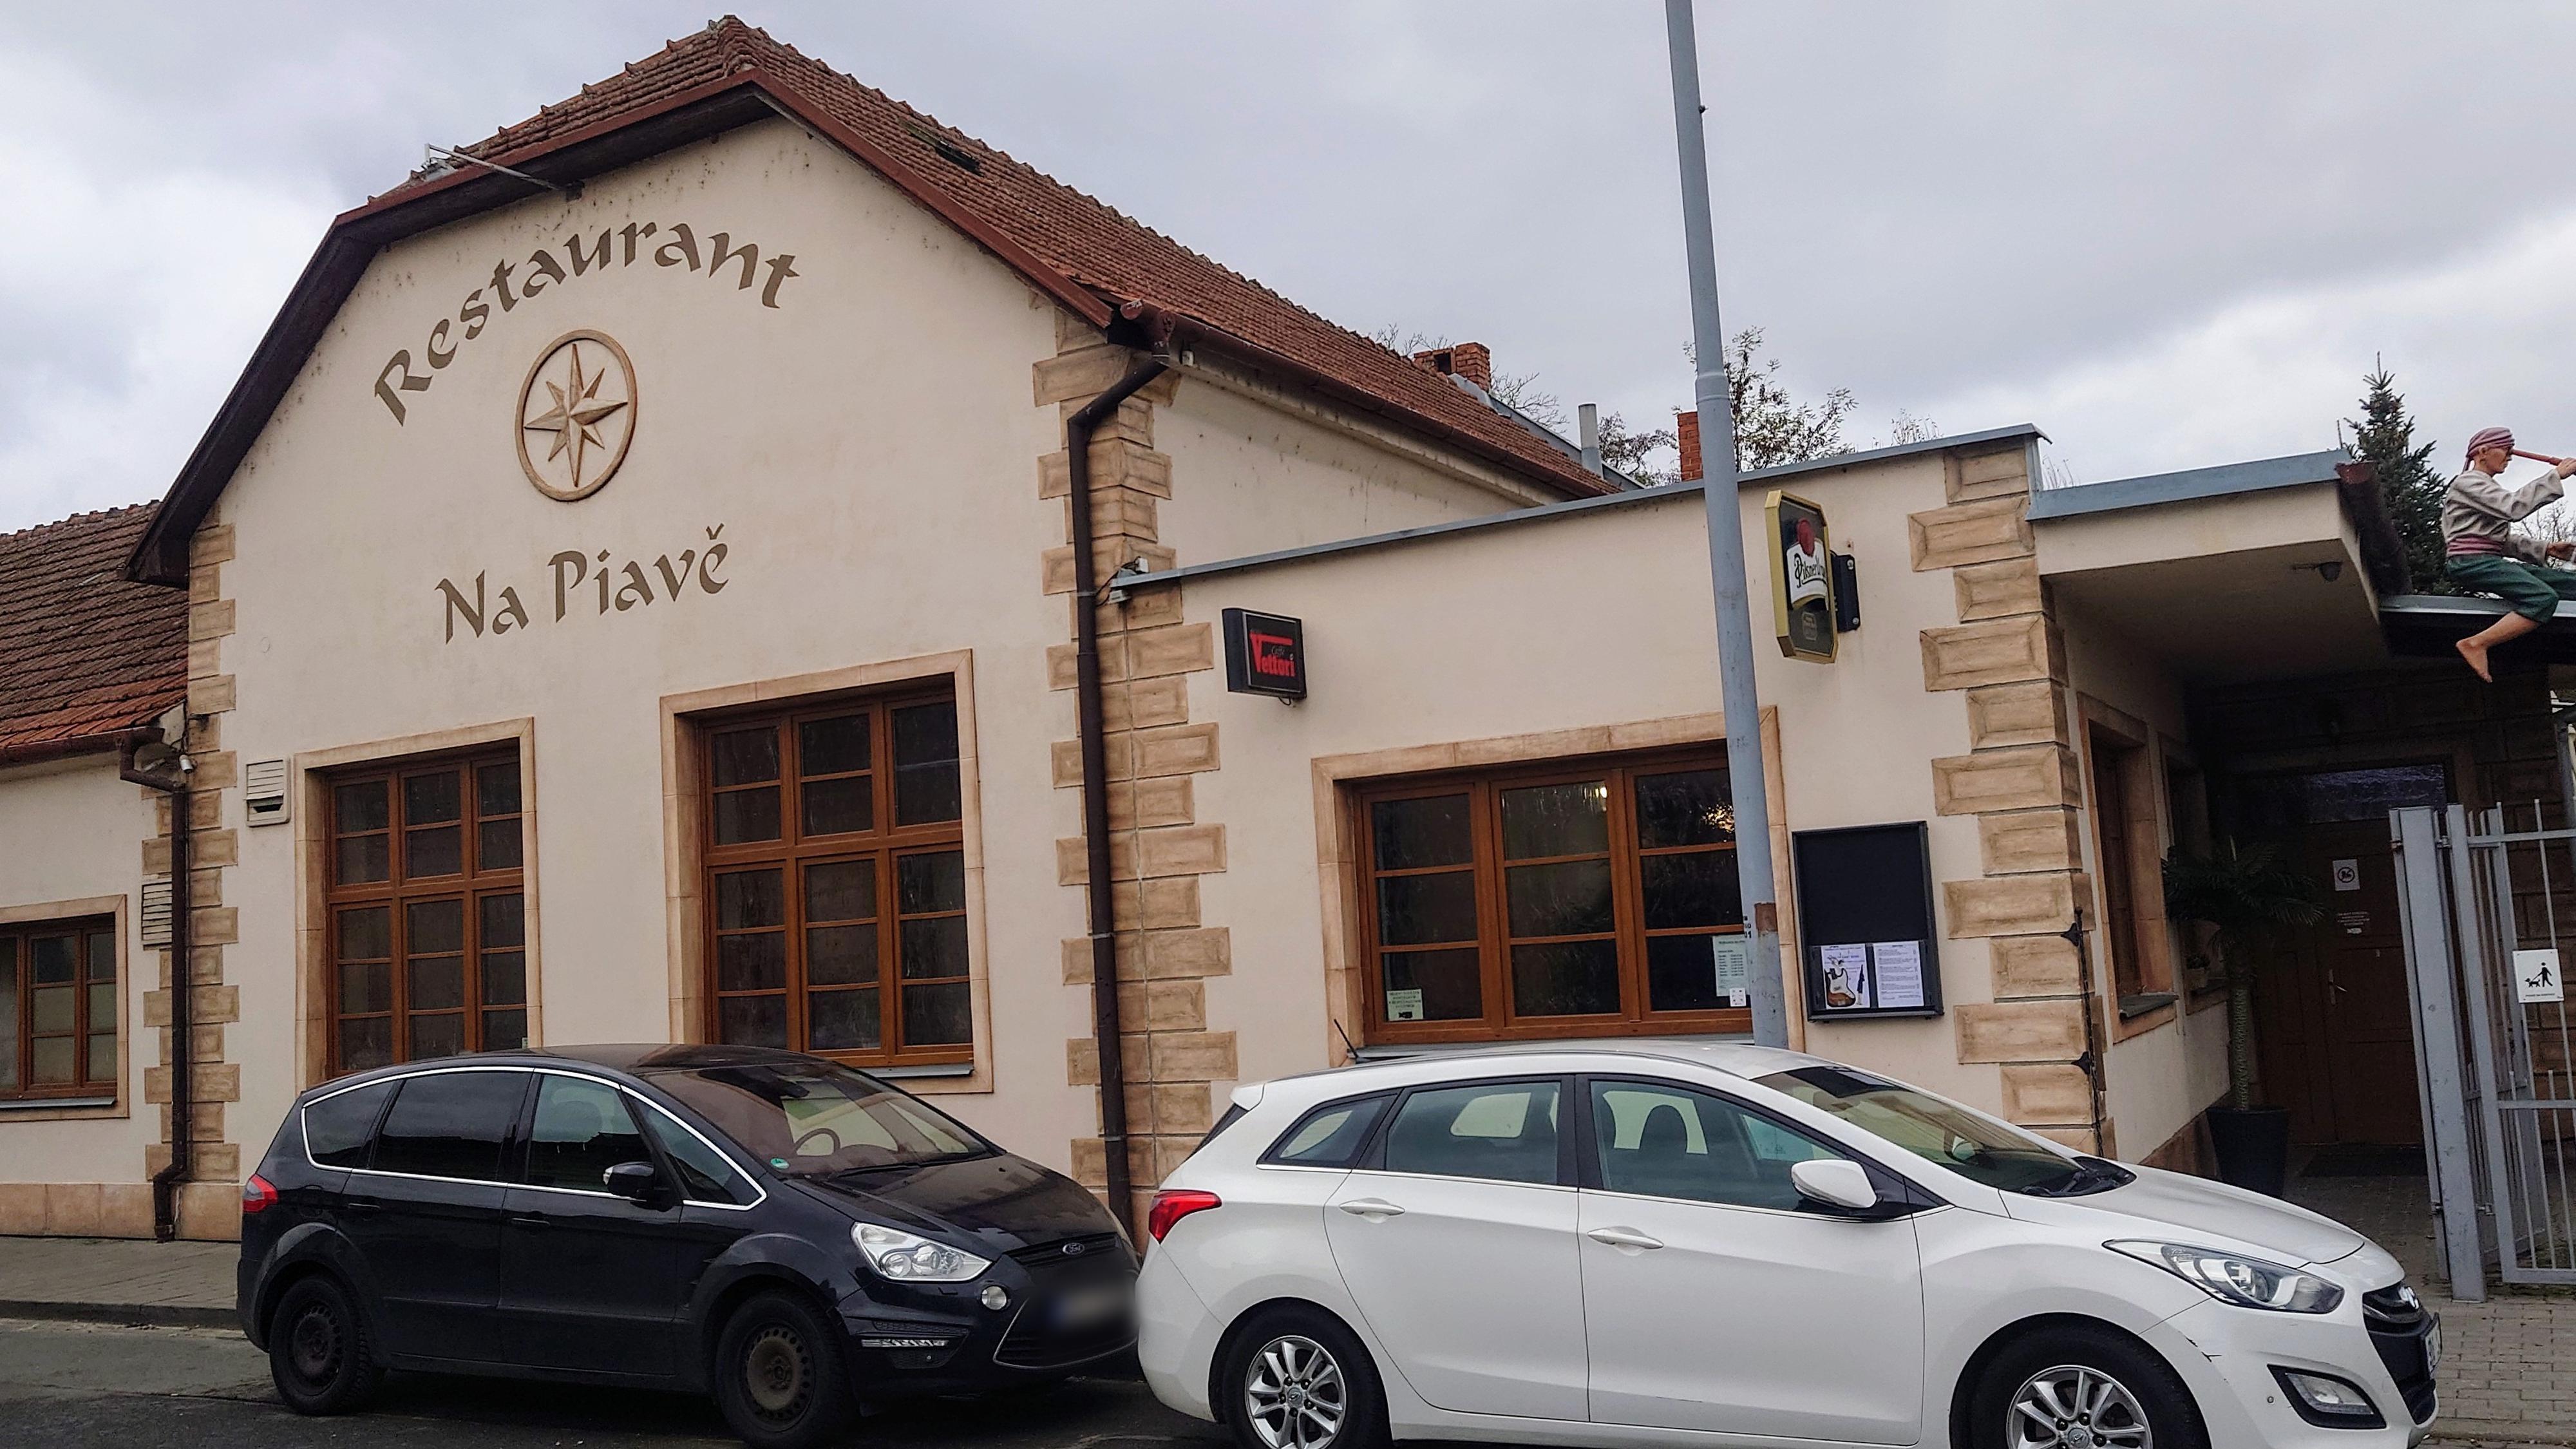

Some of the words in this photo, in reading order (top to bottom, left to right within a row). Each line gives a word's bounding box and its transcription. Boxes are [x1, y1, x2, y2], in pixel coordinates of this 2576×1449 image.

[374, 221, 800, 427] Restaurant
[434, 569, 529, 645] Na
[547, 522, 729, 623] Piavě
